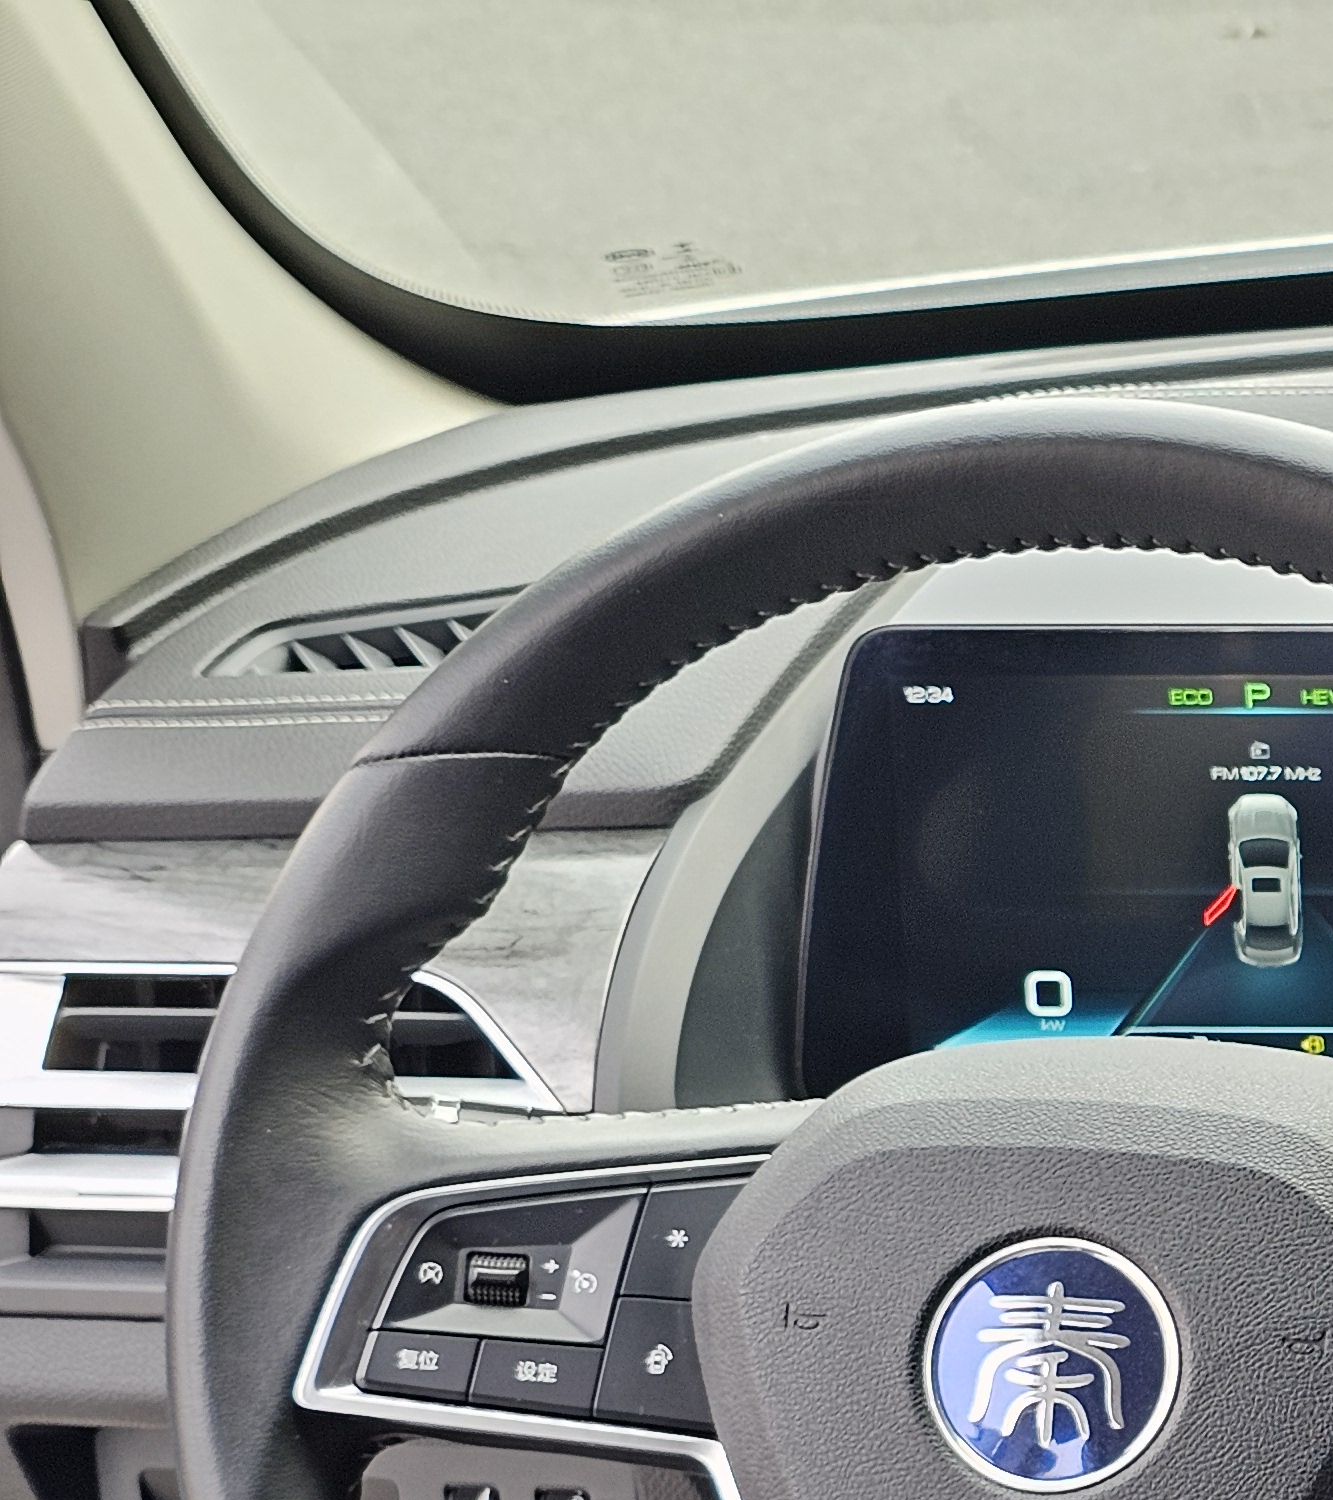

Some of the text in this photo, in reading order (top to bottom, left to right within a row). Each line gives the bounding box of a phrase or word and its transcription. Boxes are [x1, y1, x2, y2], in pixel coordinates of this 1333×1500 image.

[902, 685, 955, 704] 12:34
[1168, 688, 1214, 706] ECO
[1244, 682, 1271, 709] P
[1209, 765, 1240, 782] FM
[1240, 765, 1283, 782] 107.7
[1024, 969, 1073, 1017] 0
[396, 1348, 440, 1372] 复位
[514, 1360, 559, 1384] 设定
